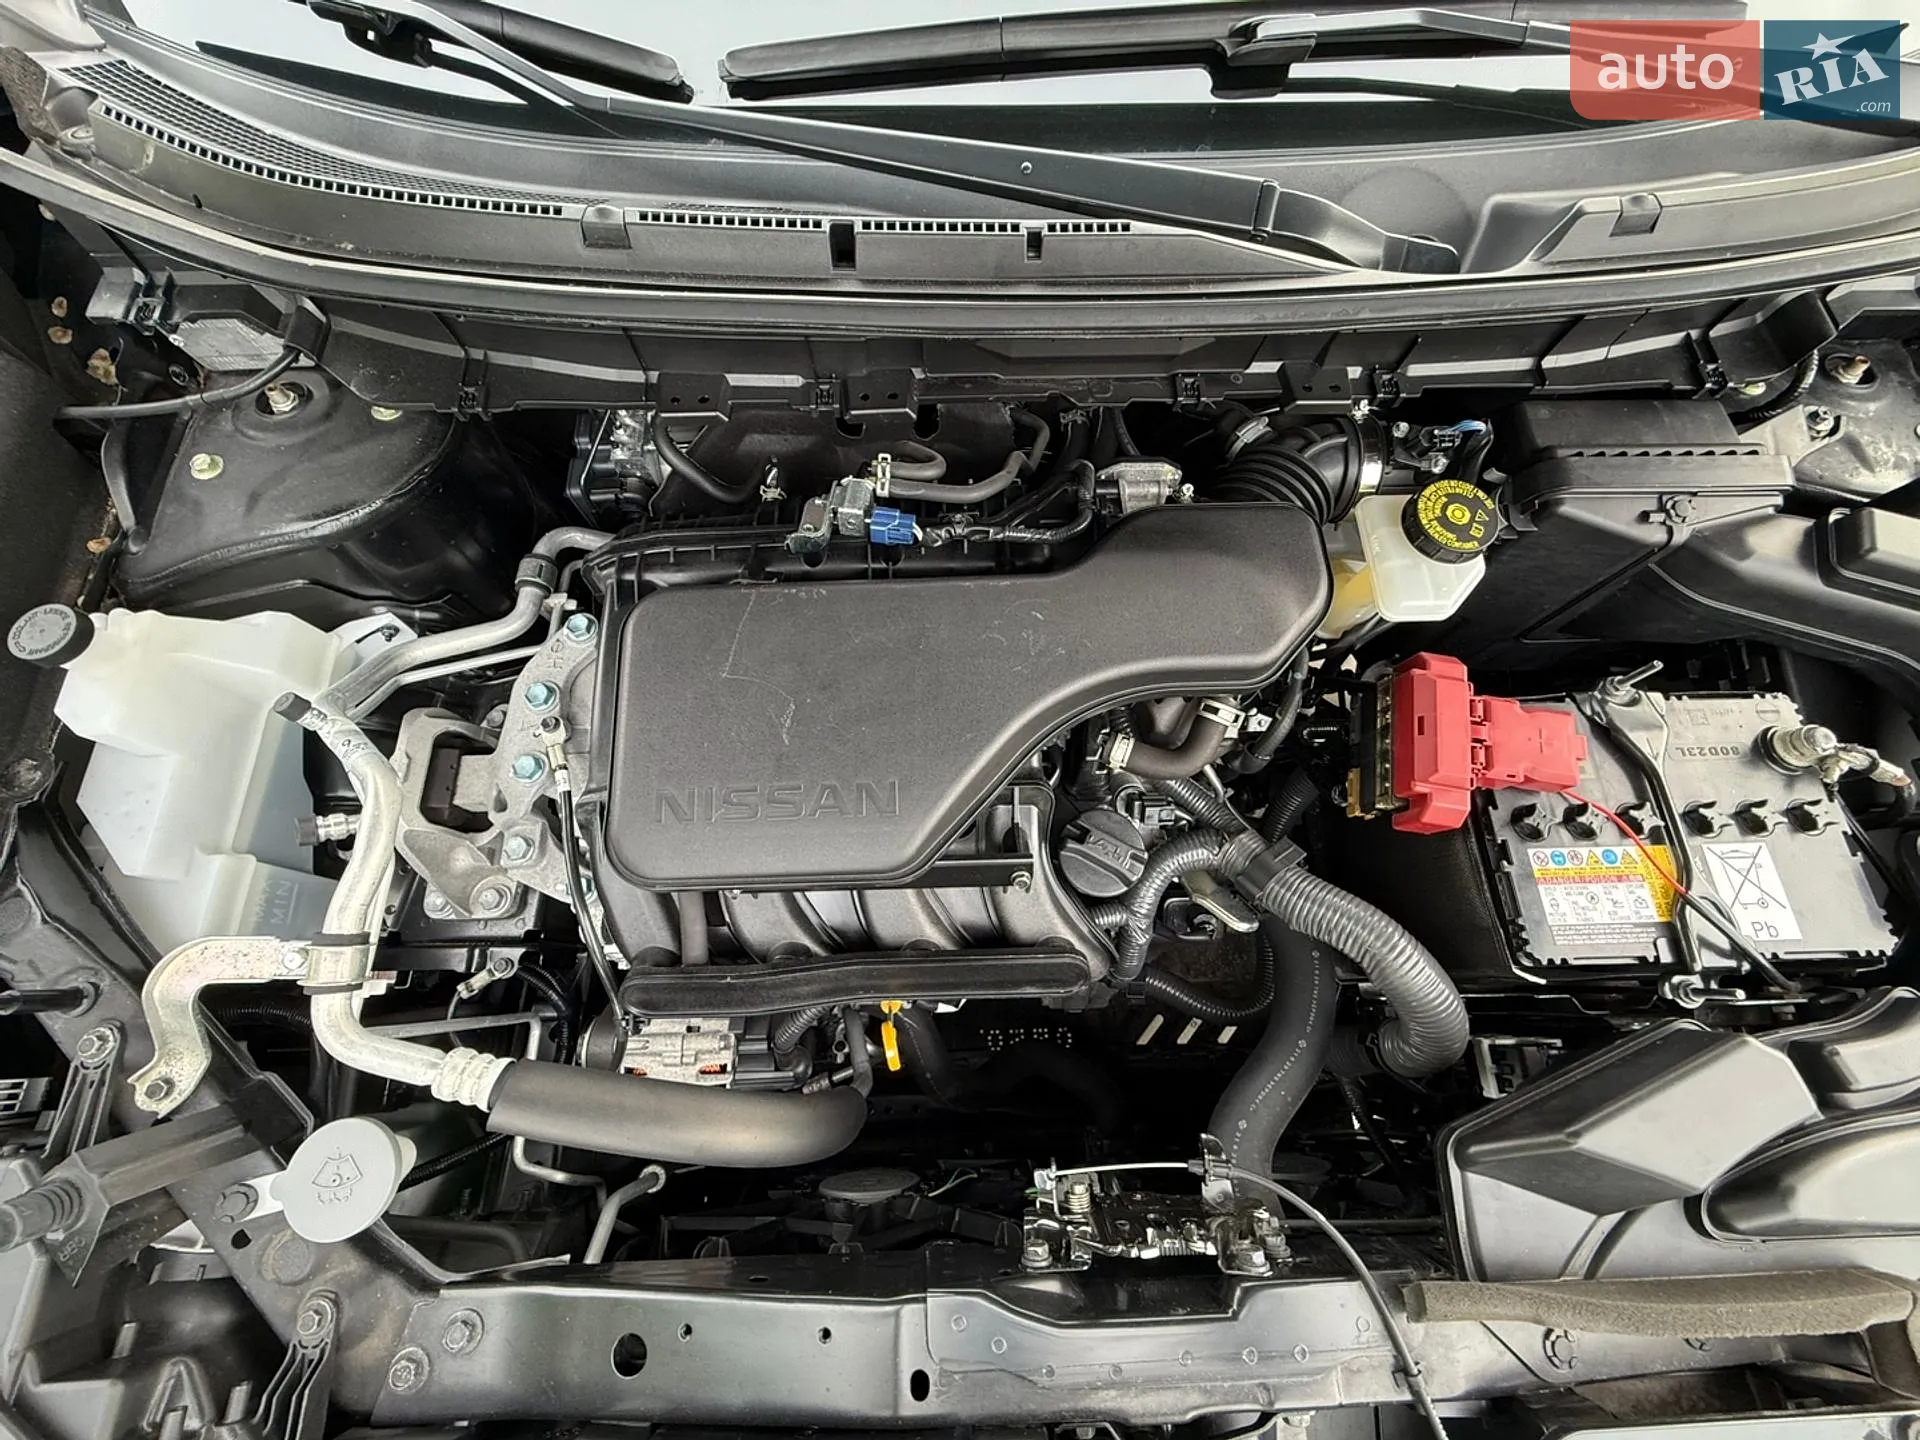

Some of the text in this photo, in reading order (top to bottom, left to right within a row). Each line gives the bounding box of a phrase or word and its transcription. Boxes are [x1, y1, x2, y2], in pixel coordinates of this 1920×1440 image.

[1674, 745, 1742, 758] 80D23L
[655, 779, 900, 825] NISSAN
[270, 879, 292, 924] MIN
[1750, 920, 1780, 939] Pb
